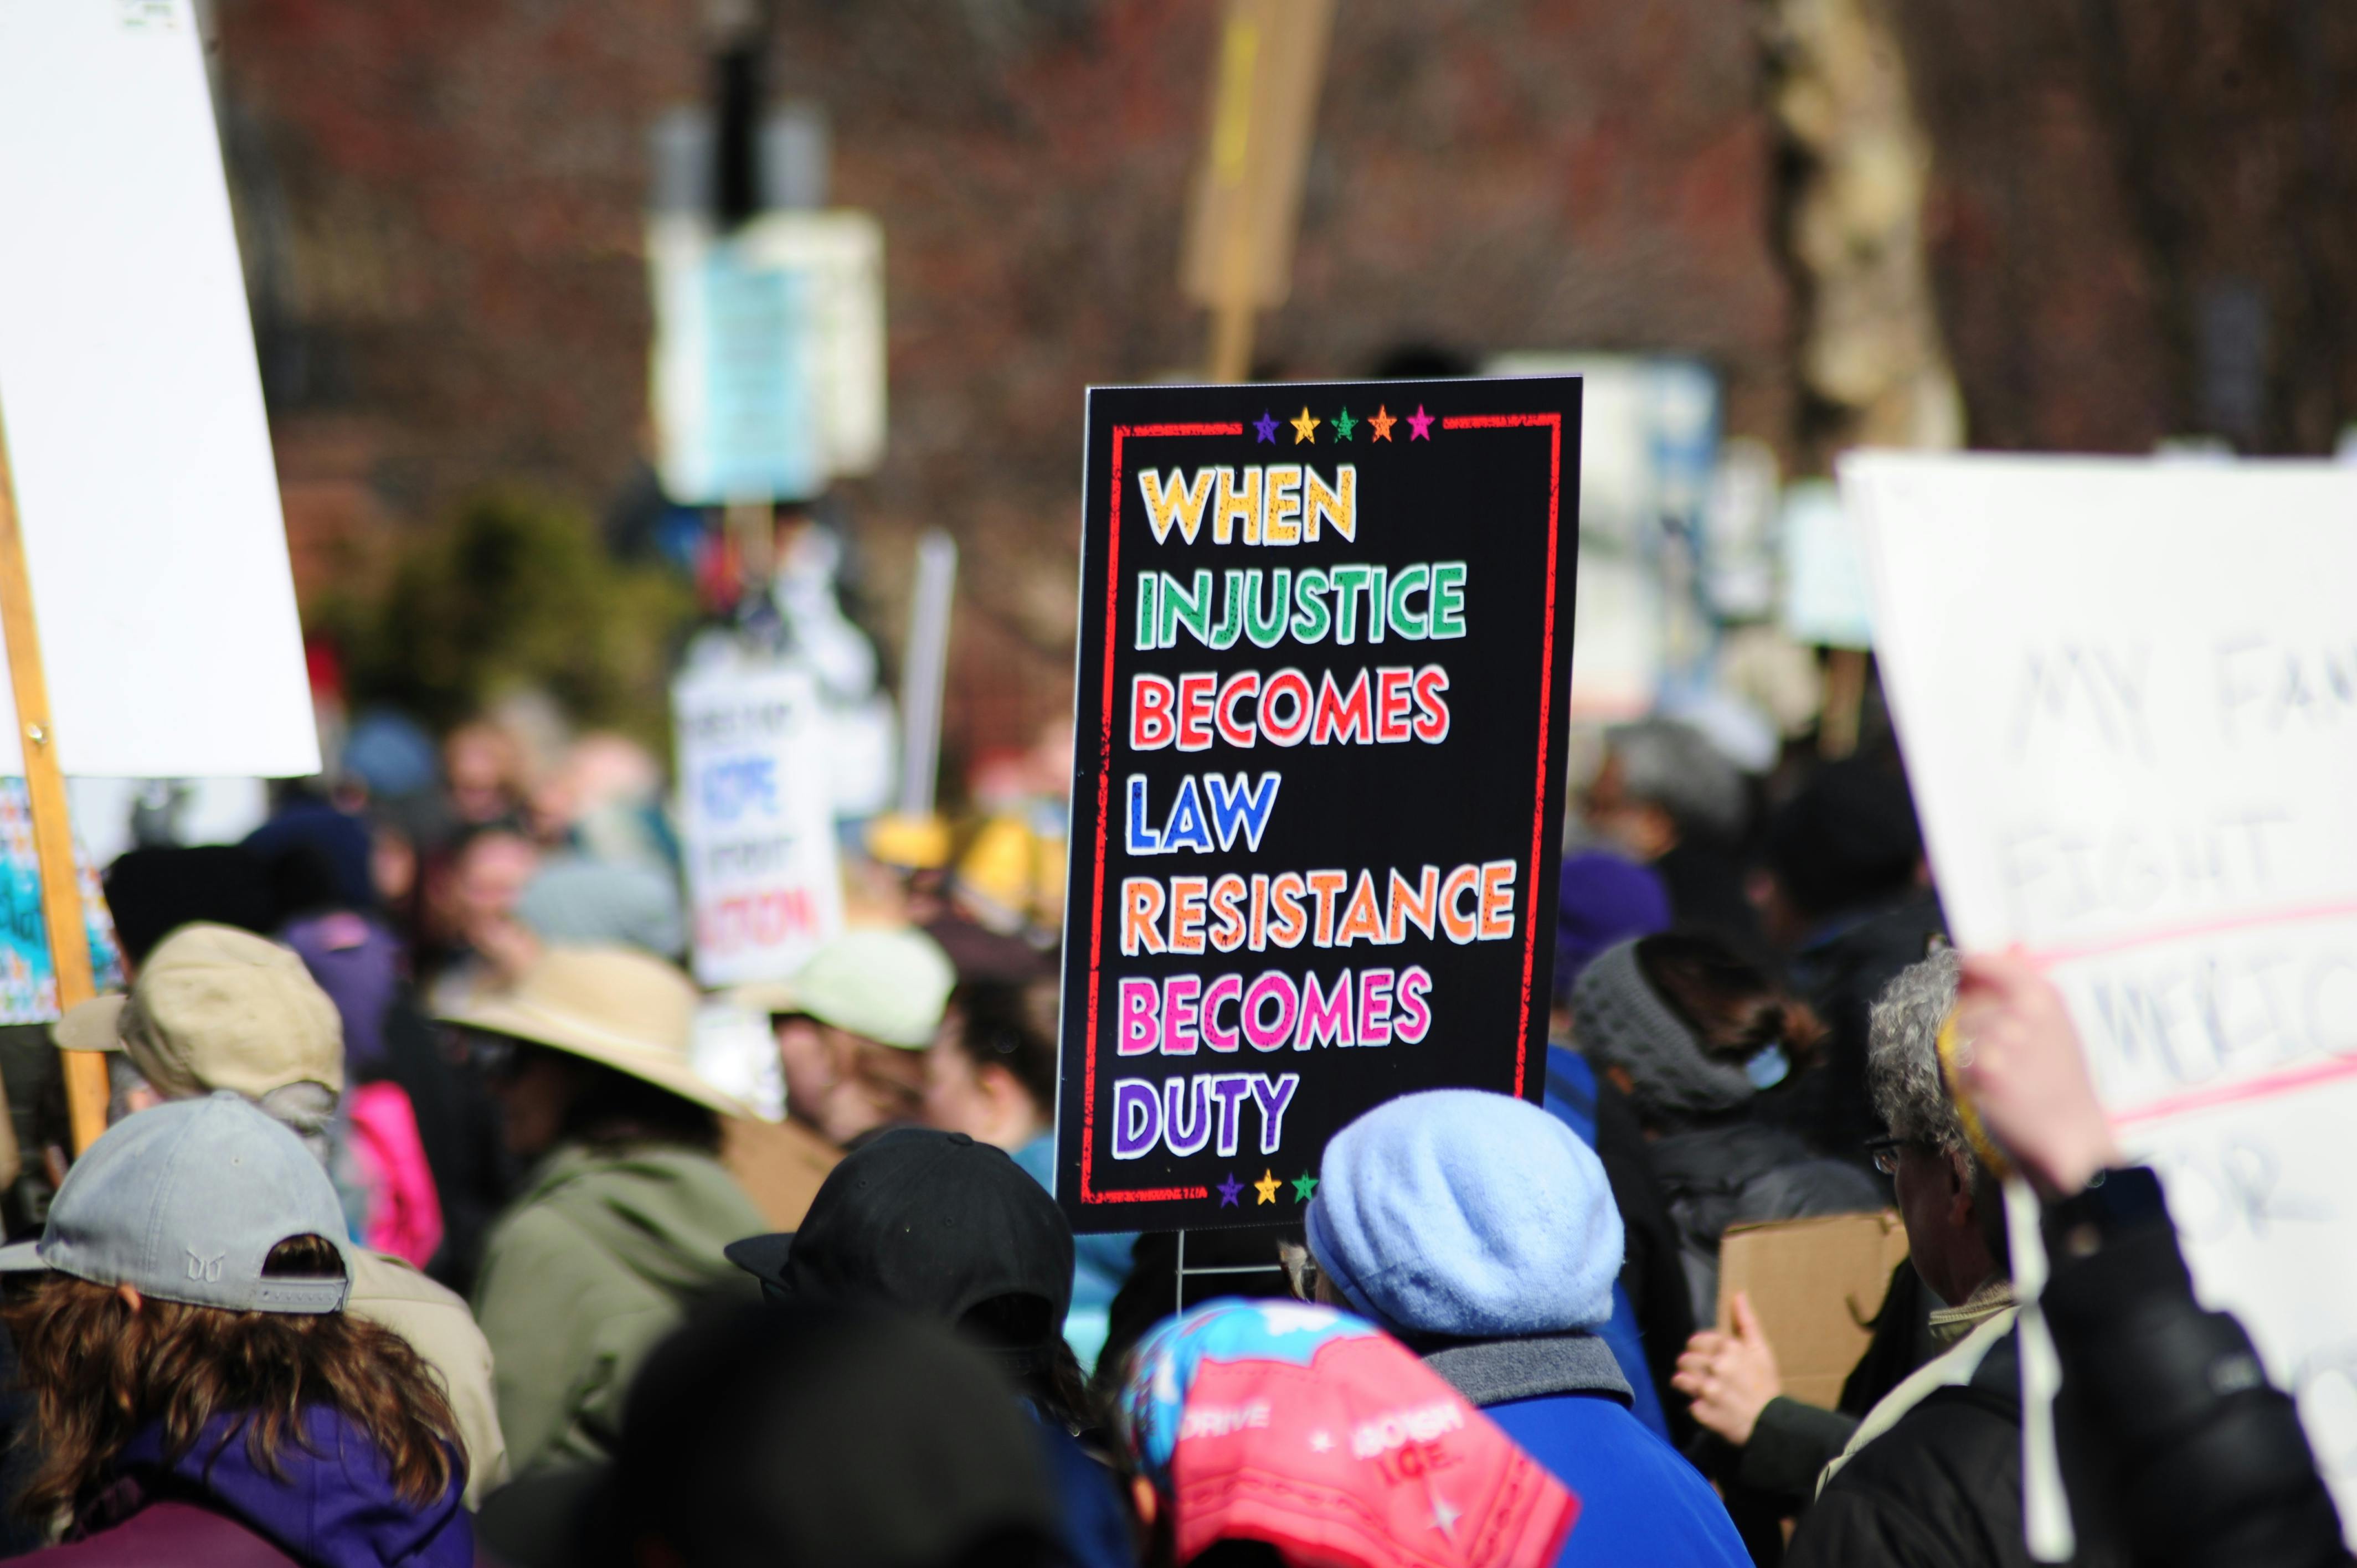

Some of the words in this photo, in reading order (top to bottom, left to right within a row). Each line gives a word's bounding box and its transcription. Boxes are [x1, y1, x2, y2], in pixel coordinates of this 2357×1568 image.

[1138, 464, 1356, 546] WHEN
[1134, 561, 1467, 651] INJUSTICE
[1130, 664, 1450, 752] BECOMES
[2006, 636, 2157, 767] MY
[1125, 772, 1282, 855] LAW
[1120, 859, 1517, 957] RESISTANCE
[1995, 803, 2298, 927] FIGHT
[1116, 965, 1432, 1056] BECOMES
[1111, 1073, 1300, 1160] DUTY
